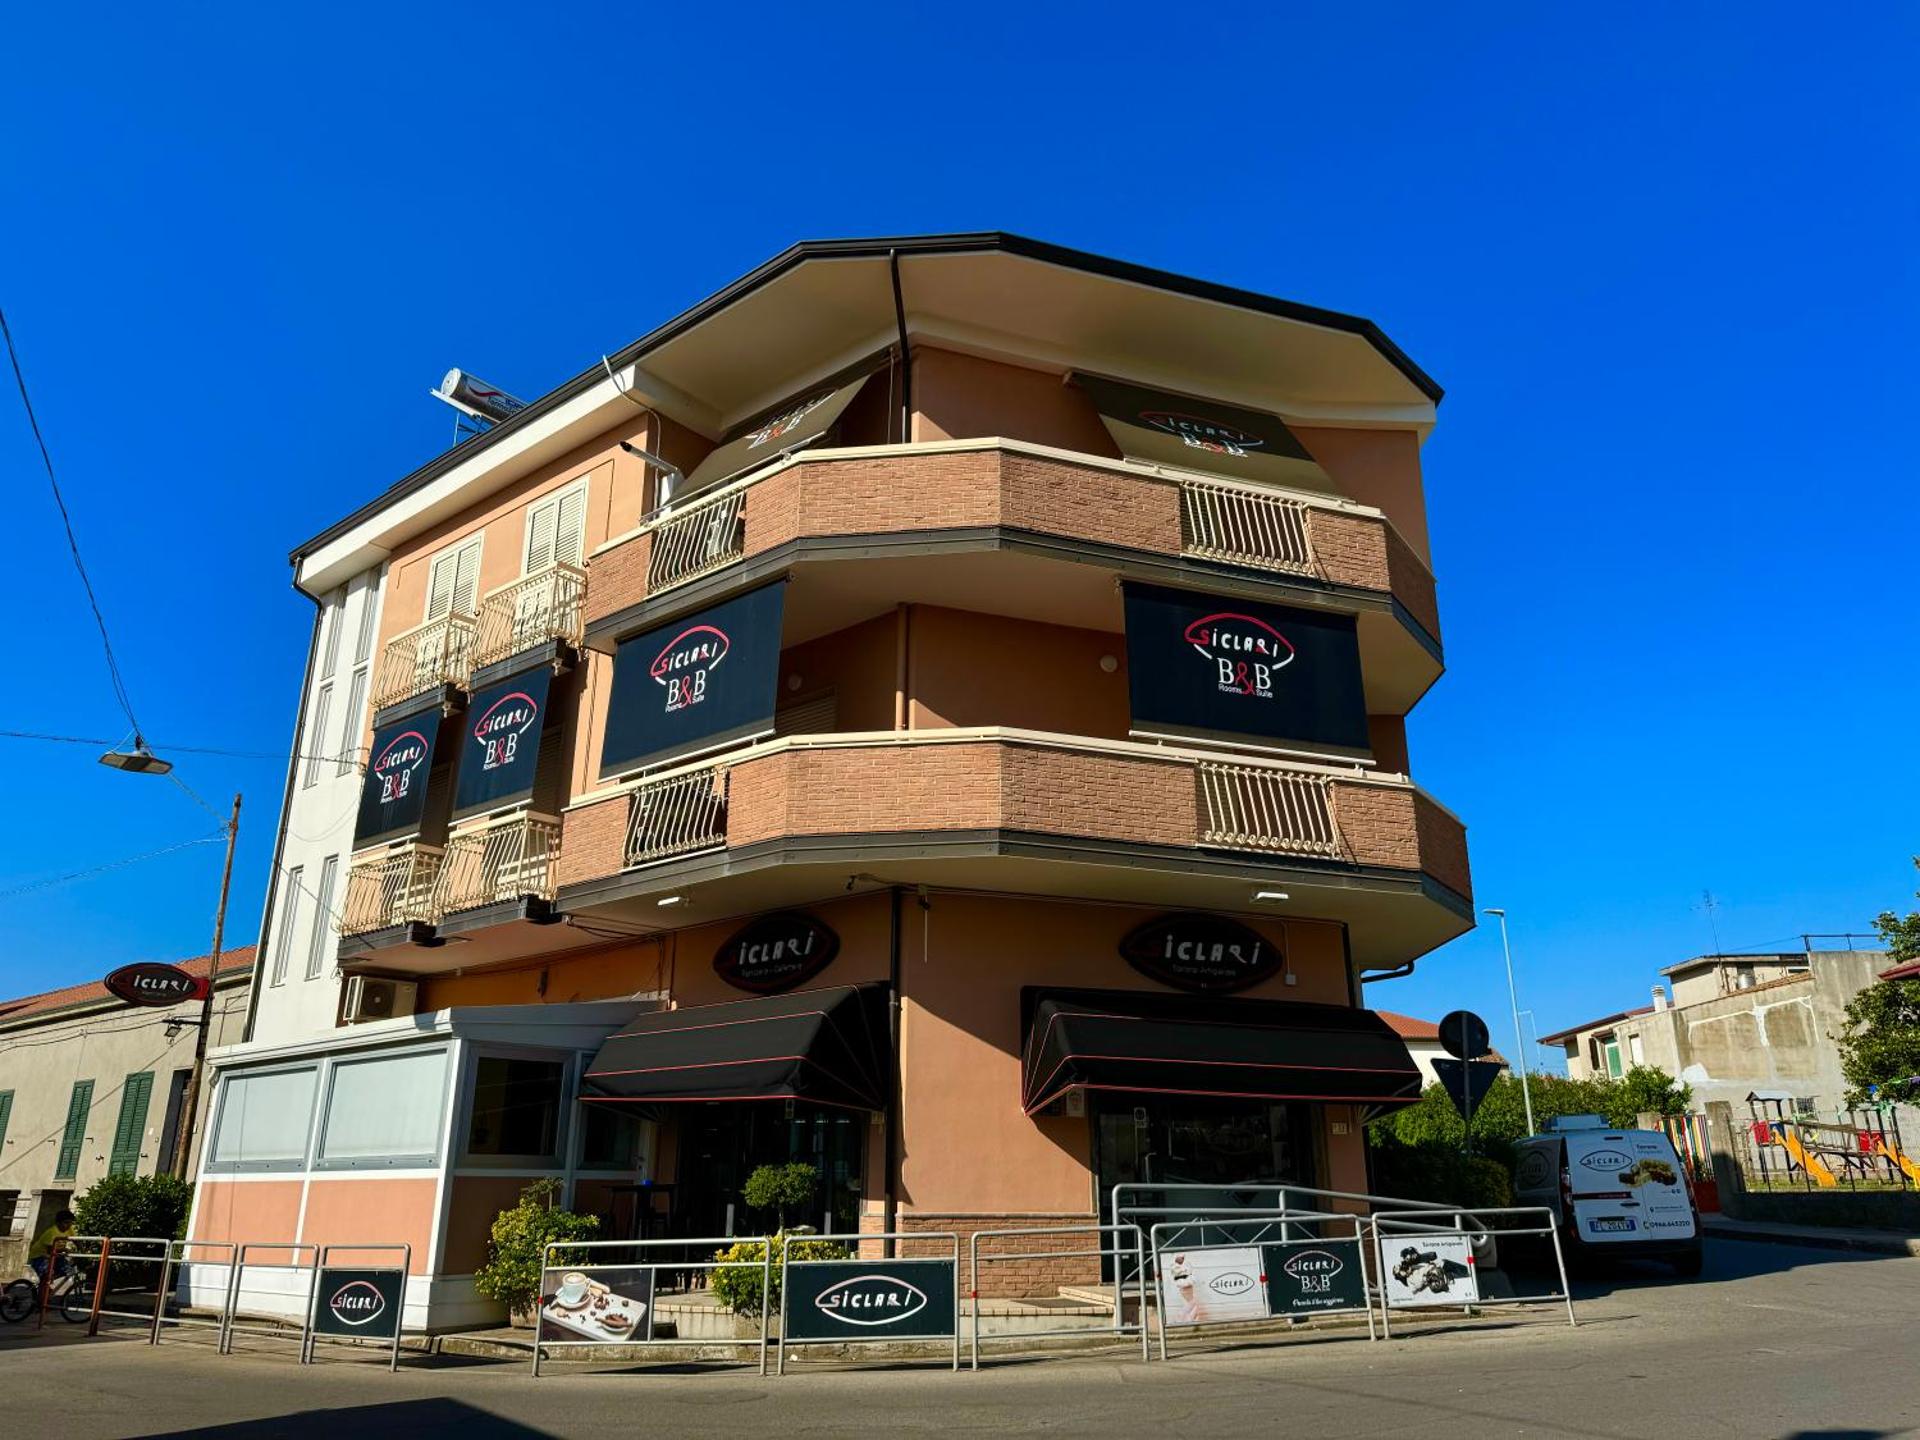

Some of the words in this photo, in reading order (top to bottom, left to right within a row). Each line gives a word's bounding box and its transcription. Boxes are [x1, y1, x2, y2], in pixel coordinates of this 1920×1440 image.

[667, 669, 706, 708] B&B
[1217, 658, 1272, 694] B&B
[485, 732, 518, 765] B&B
[382, 768, 411, 798] B&B
[1301, 1274, 1330, 1292] B&B
